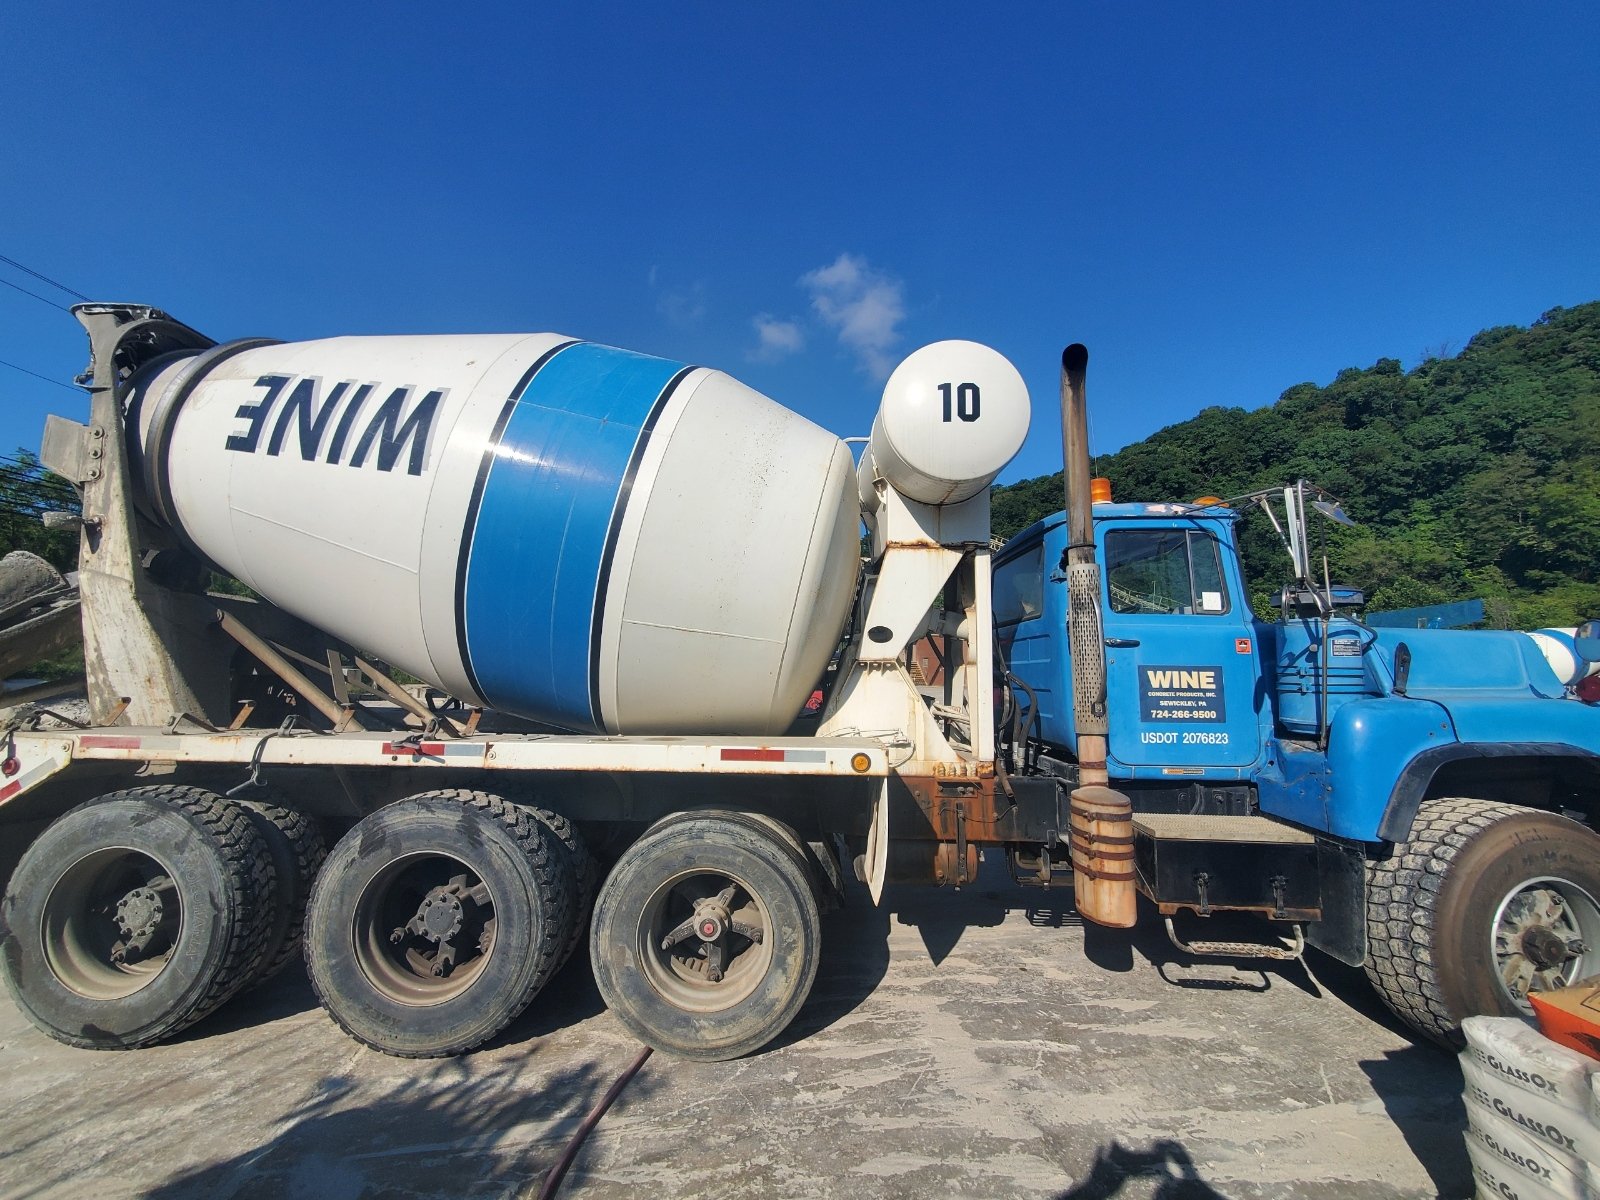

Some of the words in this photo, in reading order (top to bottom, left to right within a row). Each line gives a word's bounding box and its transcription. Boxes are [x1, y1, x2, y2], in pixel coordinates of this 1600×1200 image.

[937, 382, 981, 423] 10
[225, 375, 446, 476] WINE
[1147, 670, 1216, 689] WINE
[1150, 709, 1217, 719] 724-266-9500
[1141, 732, 1179, 744] USDOT
[1182, 732, 1229, 745] 2076823
